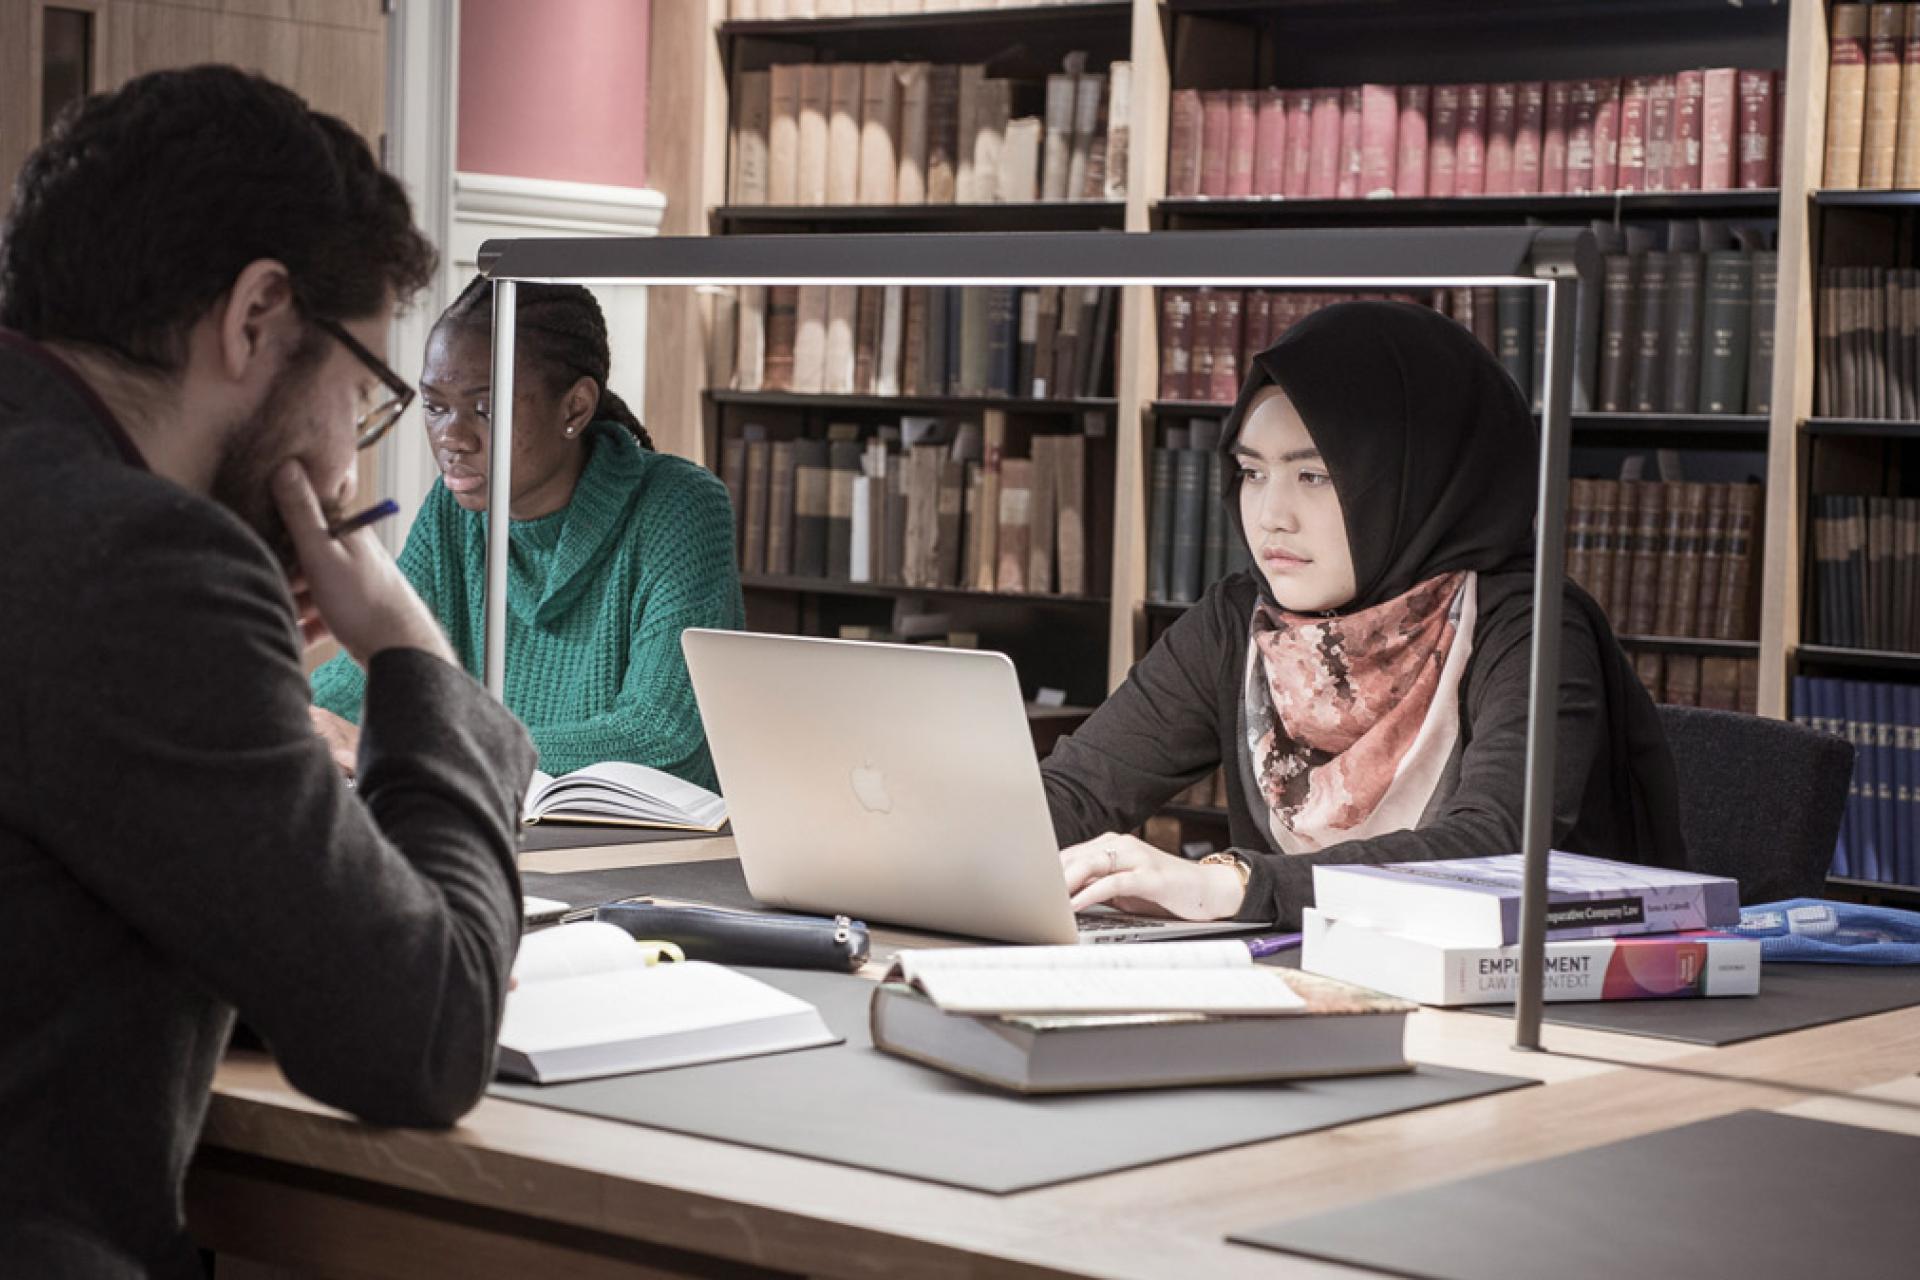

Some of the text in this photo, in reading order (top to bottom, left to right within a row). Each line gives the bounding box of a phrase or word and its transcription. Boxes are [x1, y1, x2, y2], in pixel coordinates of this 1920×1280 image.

[1585, 907, 1622, 921] Company
[1623, 904, 1640, 917] Law
[1479, 956, 1591, 975] EMPLMENT
[1479, 975, 1507, 991] LAW
